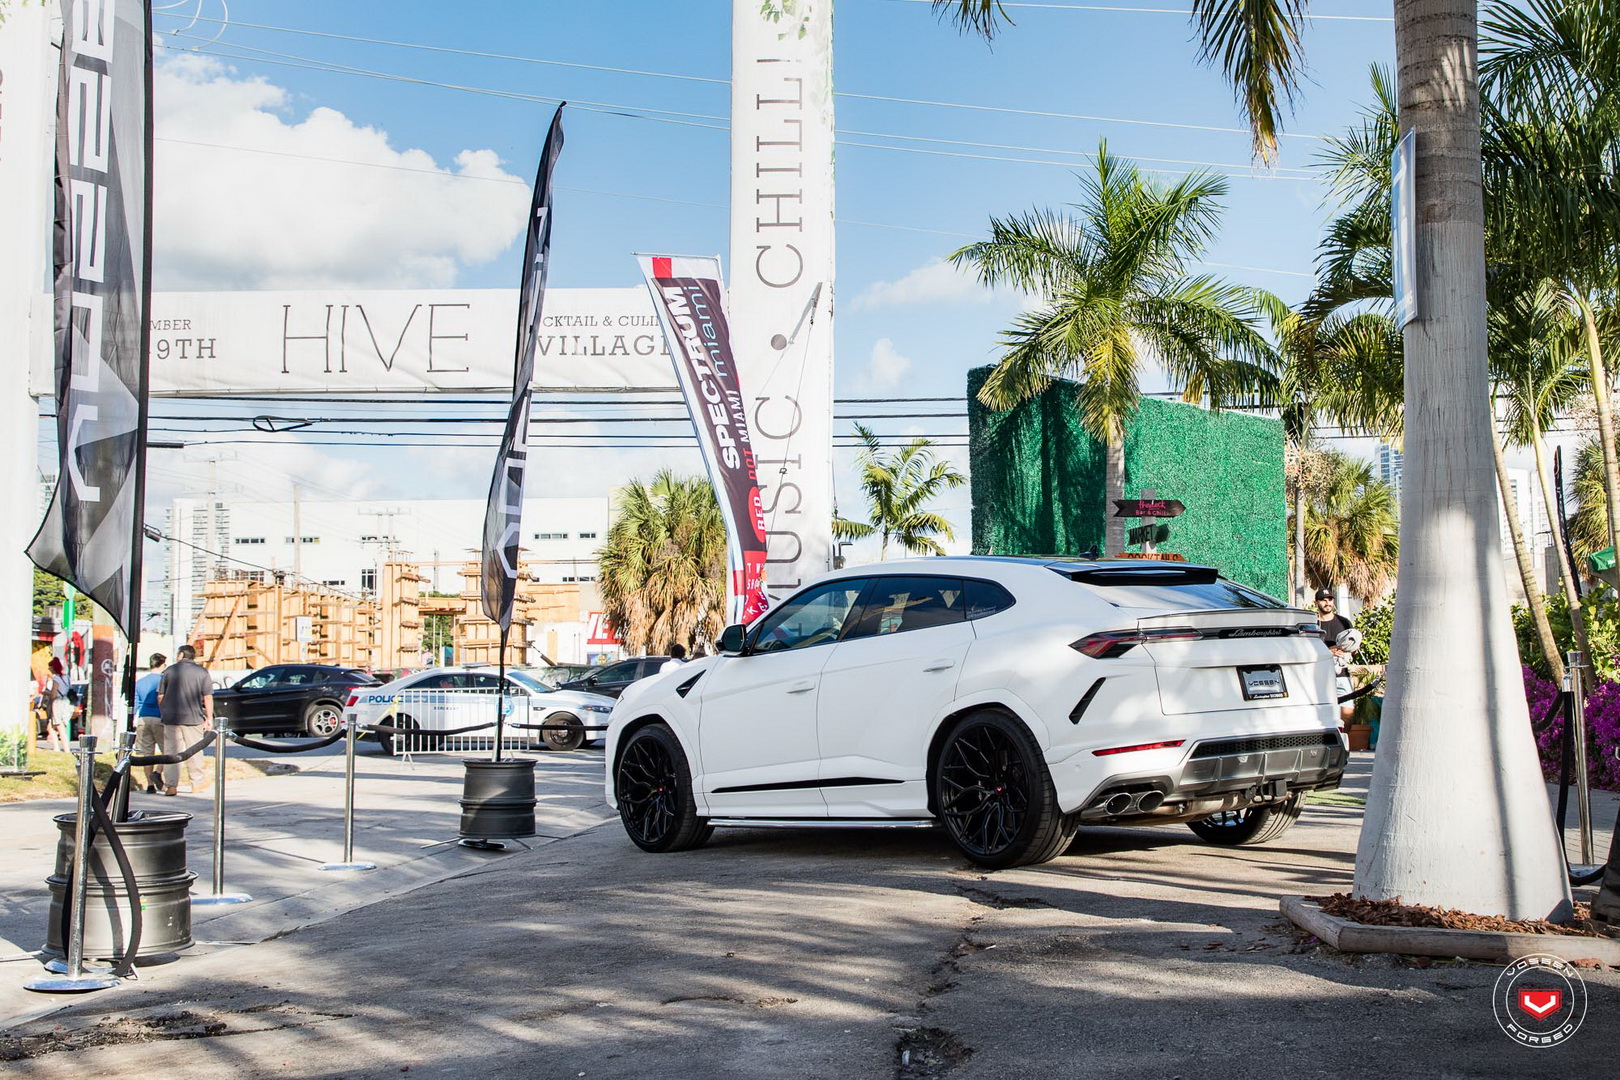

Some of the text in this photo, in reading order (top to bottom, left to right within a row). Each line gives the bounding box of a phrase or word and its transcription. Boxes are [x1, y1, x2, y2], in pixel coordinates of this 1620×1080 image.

[755, 59, 803, 287] CHILL!
[281, 303, 470, 374] HIVE
[602, 315, 613, 327] &
[684, 286, 728, 377] miami
[662, 287, 740, 470] SPECTRUM
[726, 390, 750, 443] MIAMI
